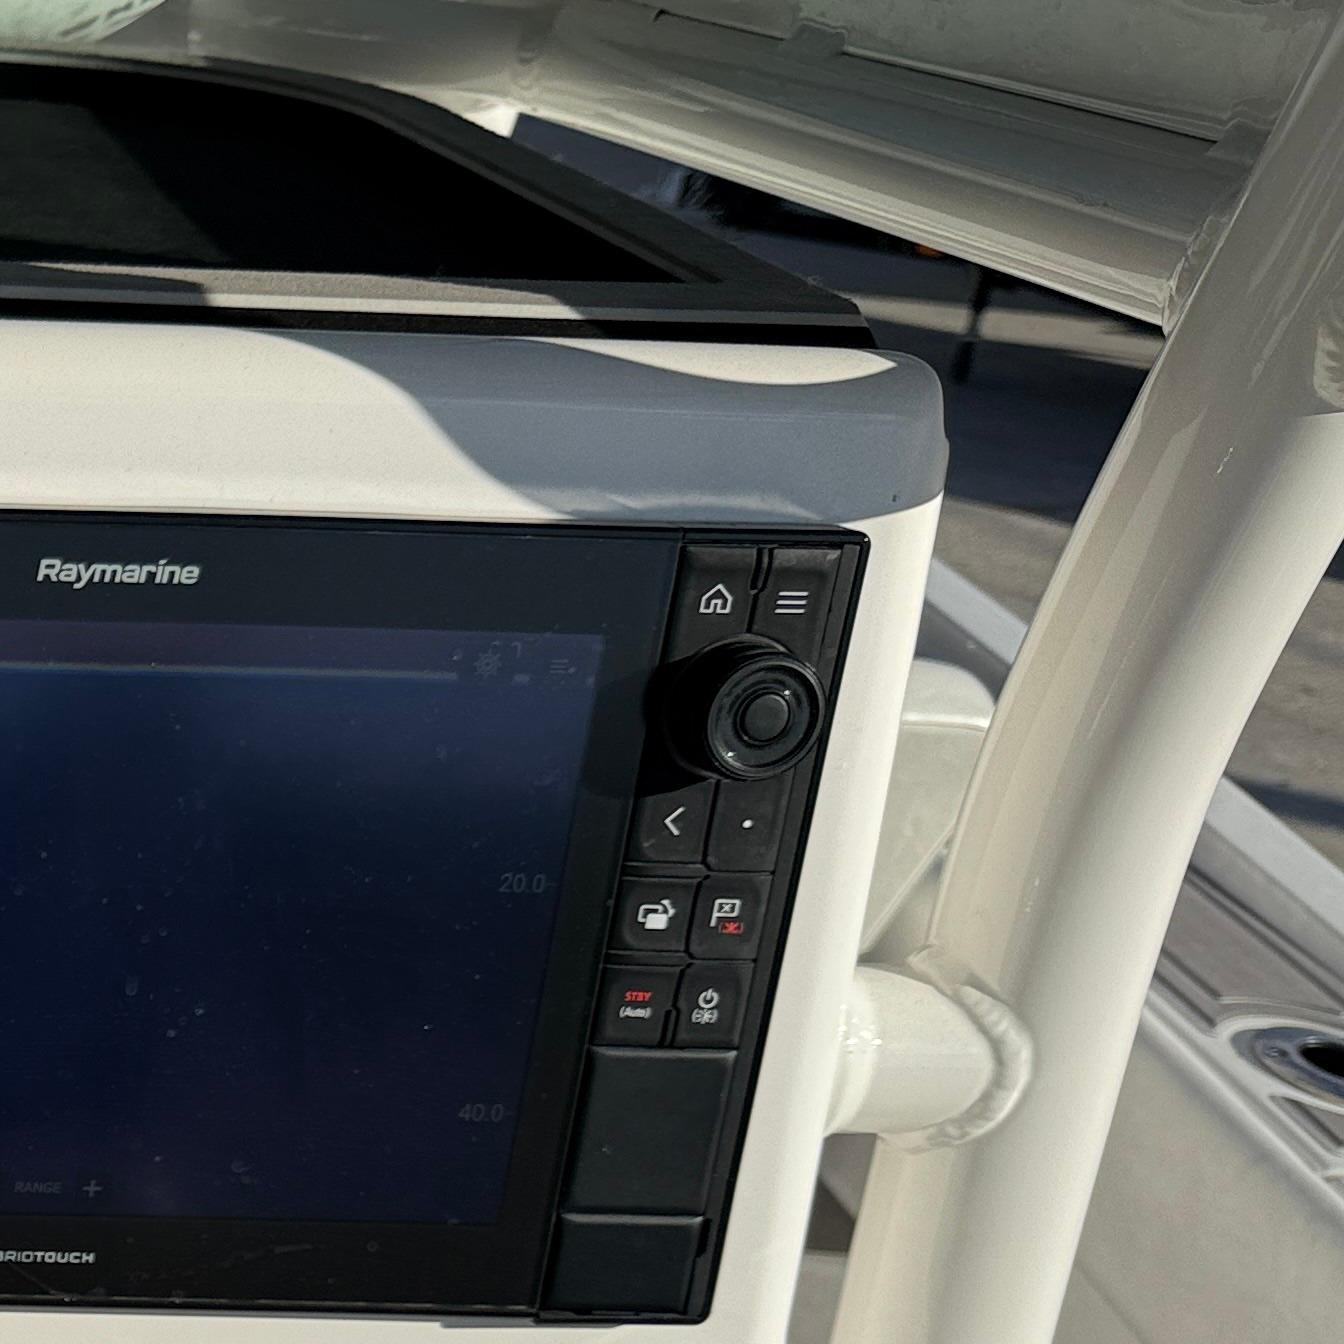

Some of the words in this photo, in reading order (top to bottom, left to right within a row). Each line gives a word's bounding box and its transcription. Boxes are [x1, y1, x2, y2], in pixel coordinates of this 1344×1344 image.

[36, 557, 201, 590] Raymarine
[498, 873, 547, 894] 20.0
[619, 1005, 652, 1019] (Auto)
[457, 1103, 504, 1124] 40.0
